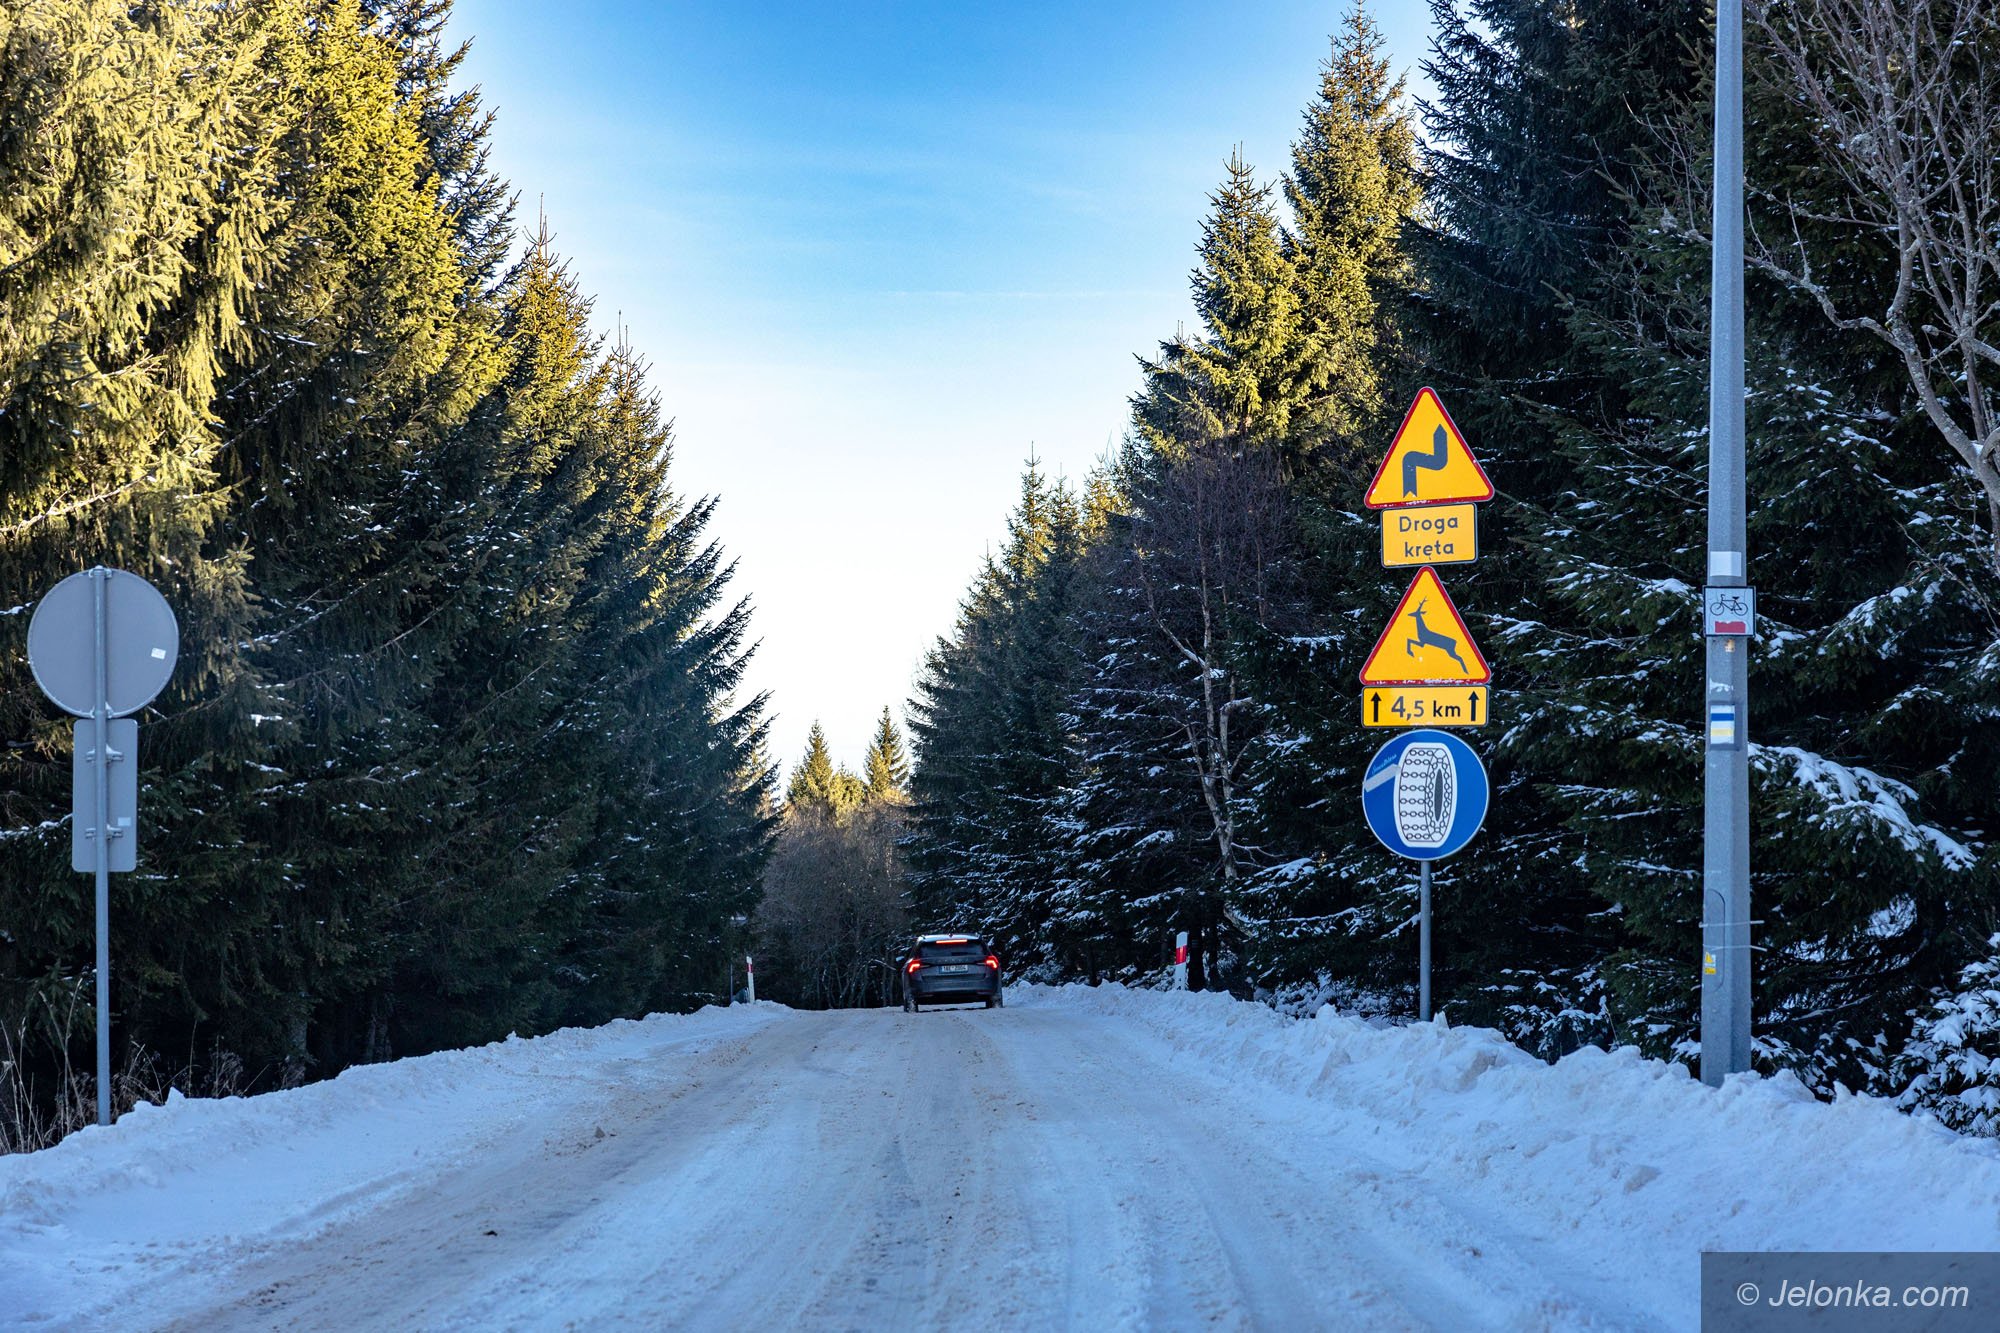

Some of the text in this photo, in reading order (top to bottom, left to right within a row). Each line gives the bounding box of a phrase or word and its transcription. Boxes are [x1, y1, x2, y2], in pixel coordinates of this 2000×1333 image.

[1399, 516, 1459, 535] Droga
[1404, 540, 1454, 560] kręta
[1391, 695, 1461, 721] 4,5 km
